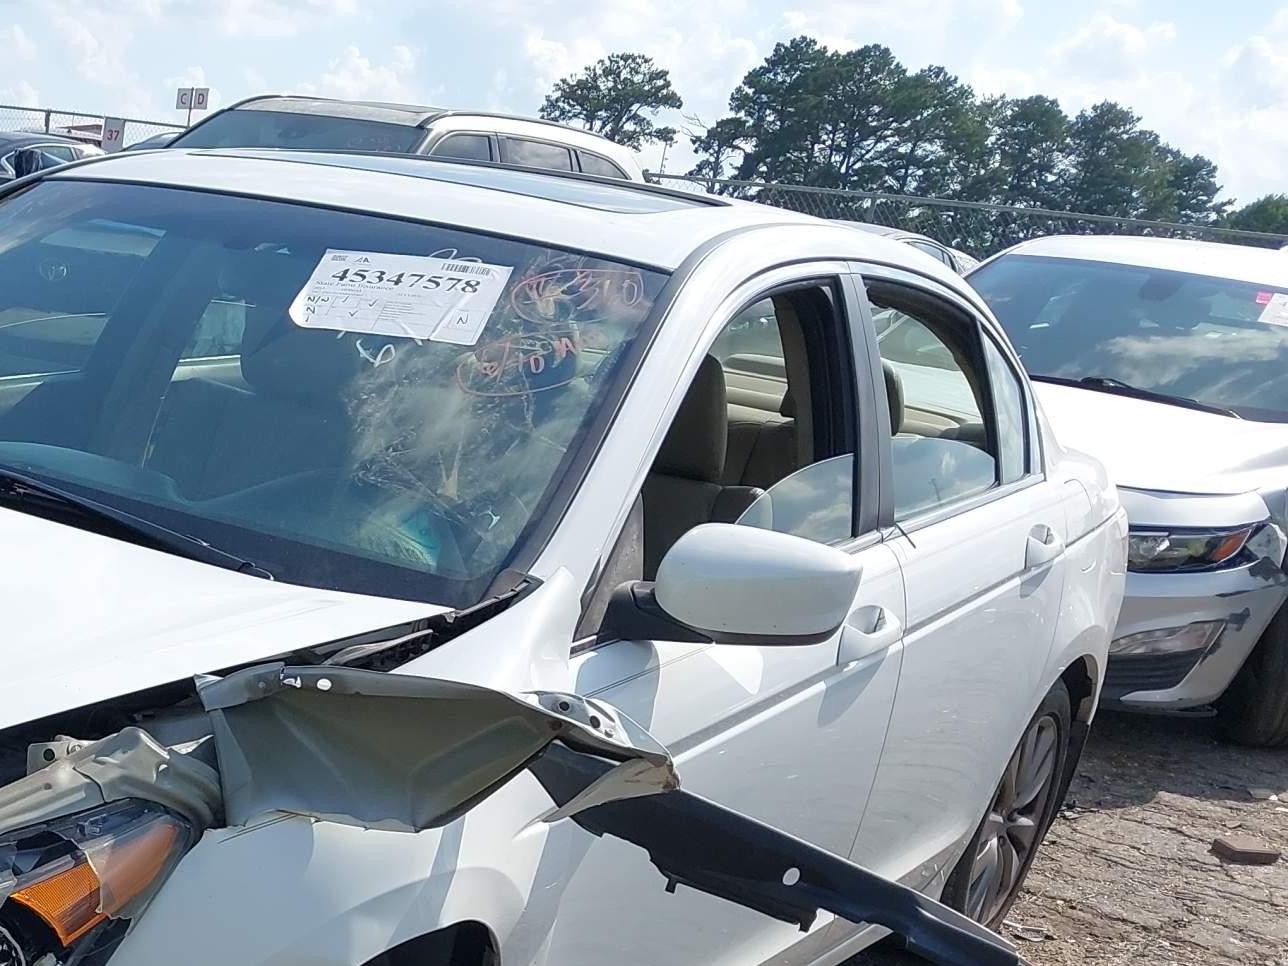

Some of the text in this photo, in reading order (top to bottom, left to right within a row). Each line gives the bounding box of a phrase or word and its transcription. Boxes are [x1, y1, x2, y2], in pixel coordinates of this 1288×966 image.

[180, 93, 187, 104] C
[197, 93, 204, 104] D
[106, 130, 120, 141] 37
[331, 267, 481, 294] 45347578
